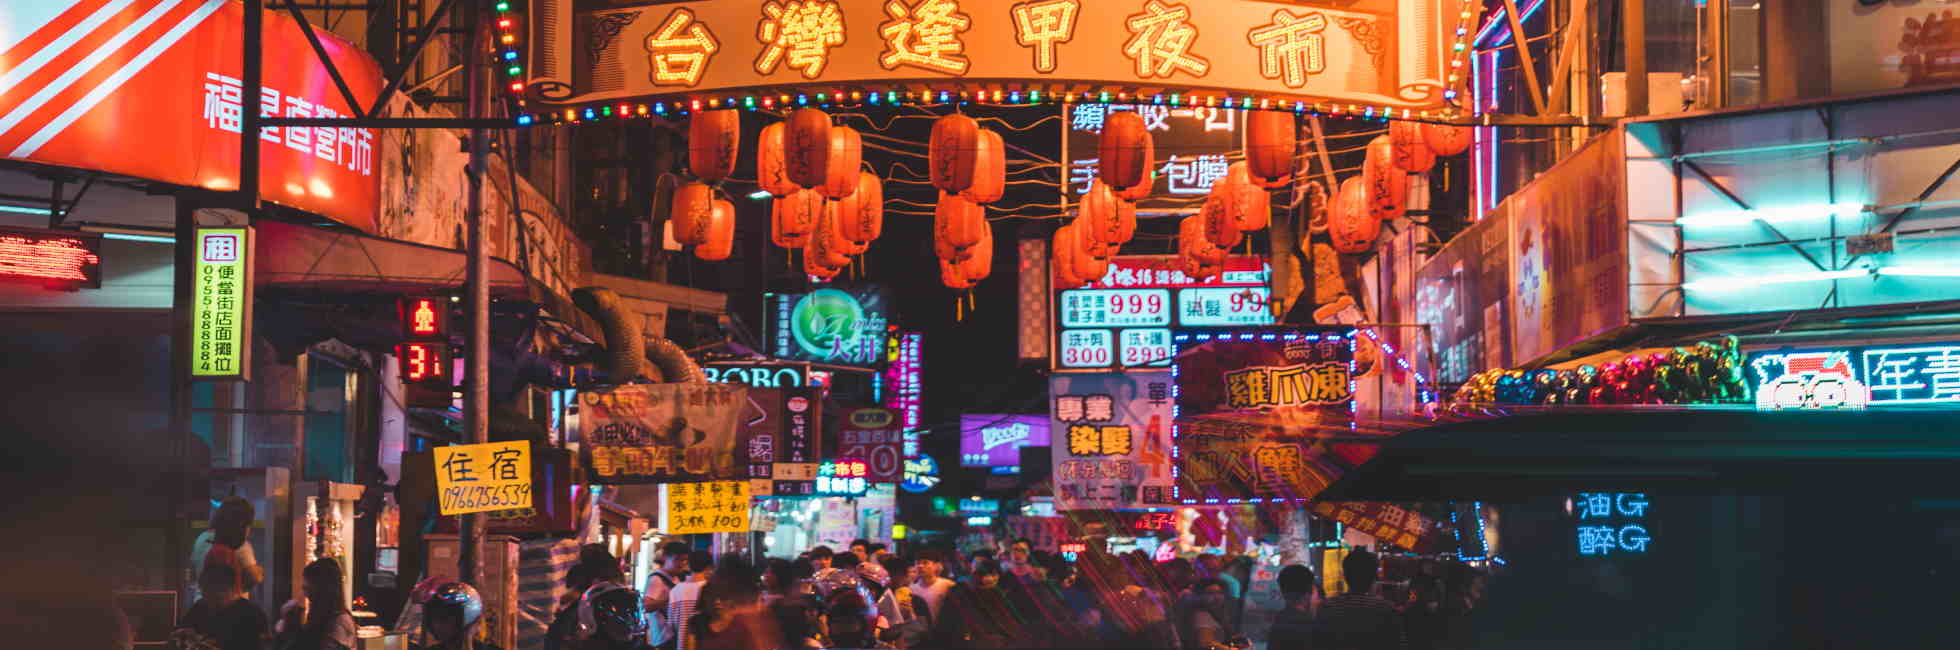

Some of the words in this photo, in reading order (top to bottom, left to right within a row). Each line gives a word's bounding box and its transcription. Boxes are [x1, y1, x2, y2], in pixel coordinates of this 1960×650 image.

[647, 0, 1327, 88] 台灣逢甲夜市
[204, 72, 373, 176] 福星直營門市
[206, 239, 234, 258] 租
[215, 265, 234, 371] 便當街店面攤位
[1110, 294, 1162, 315] 999
[1229, 363, 1349, 408] 雞爪凍
[442, 447, 521, 483] 住宿
[443, 483, 530, 511] 0966756539
